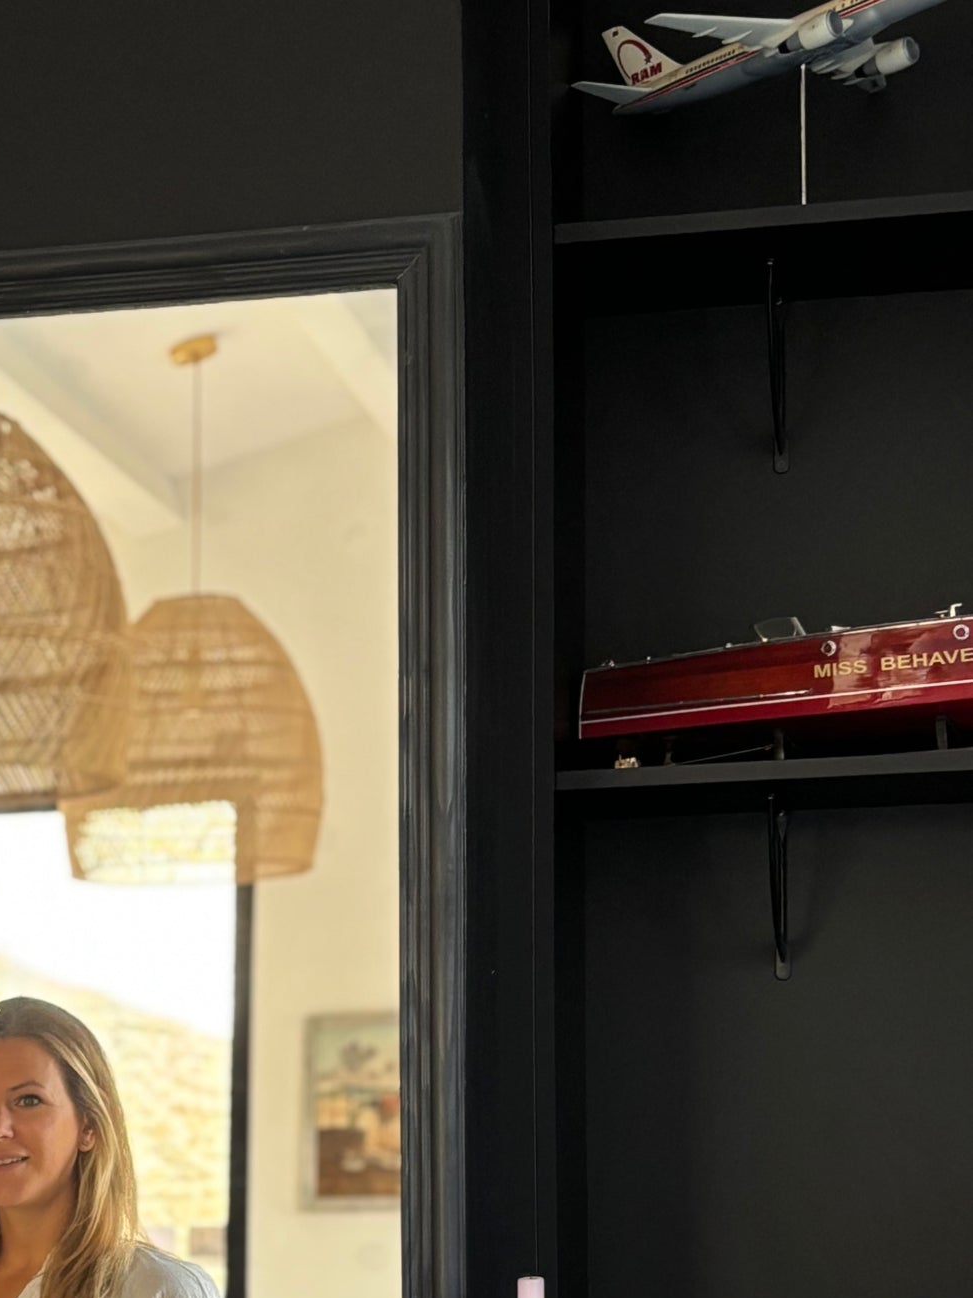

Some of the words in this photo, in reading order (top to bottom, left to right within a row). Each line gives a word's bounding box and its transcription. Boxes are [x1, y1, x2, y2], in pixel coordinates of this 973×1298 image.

[631, 62, 663, 85] RAM
[813, 659, 868, 679] MISS
[880, 647, 973, 672] BEHAVE
